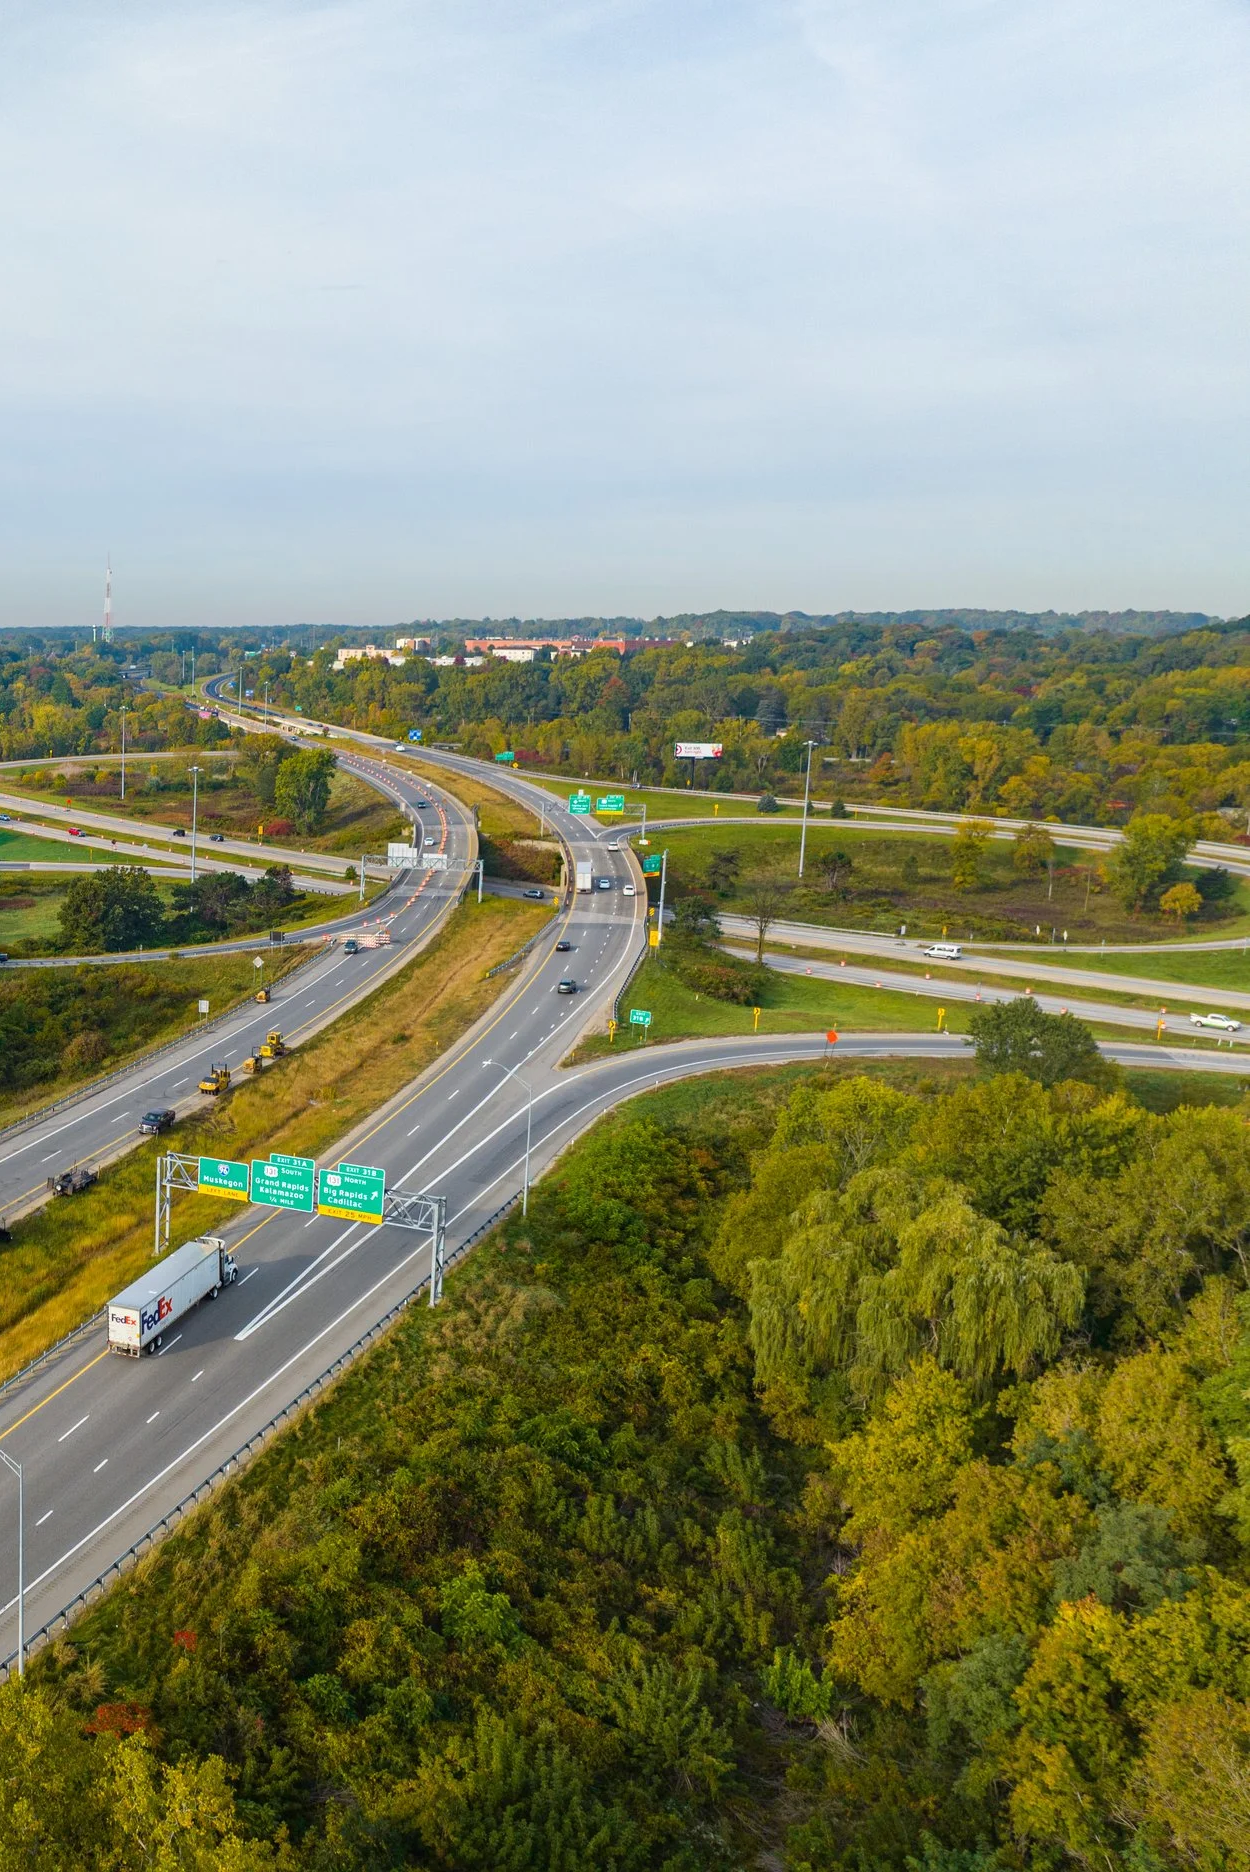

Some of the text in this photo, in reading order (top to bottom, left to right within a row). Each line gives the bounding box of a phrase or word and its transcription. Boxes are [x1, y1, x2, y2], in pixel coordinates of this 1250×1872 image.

[203, 1175, 243, 1188] Muskegon
[255, 1177, 309, 1192] Grand Rapids
[260, 1186, 304, 1200] Kalamazoo
[324, 1187, 368, 1200] Big Rapids
[327, 1196, 362, 1208] Cadillac
[111, 1313, 136, 1326] FedEx
[142, 1296, 172, 1335] FedEx
